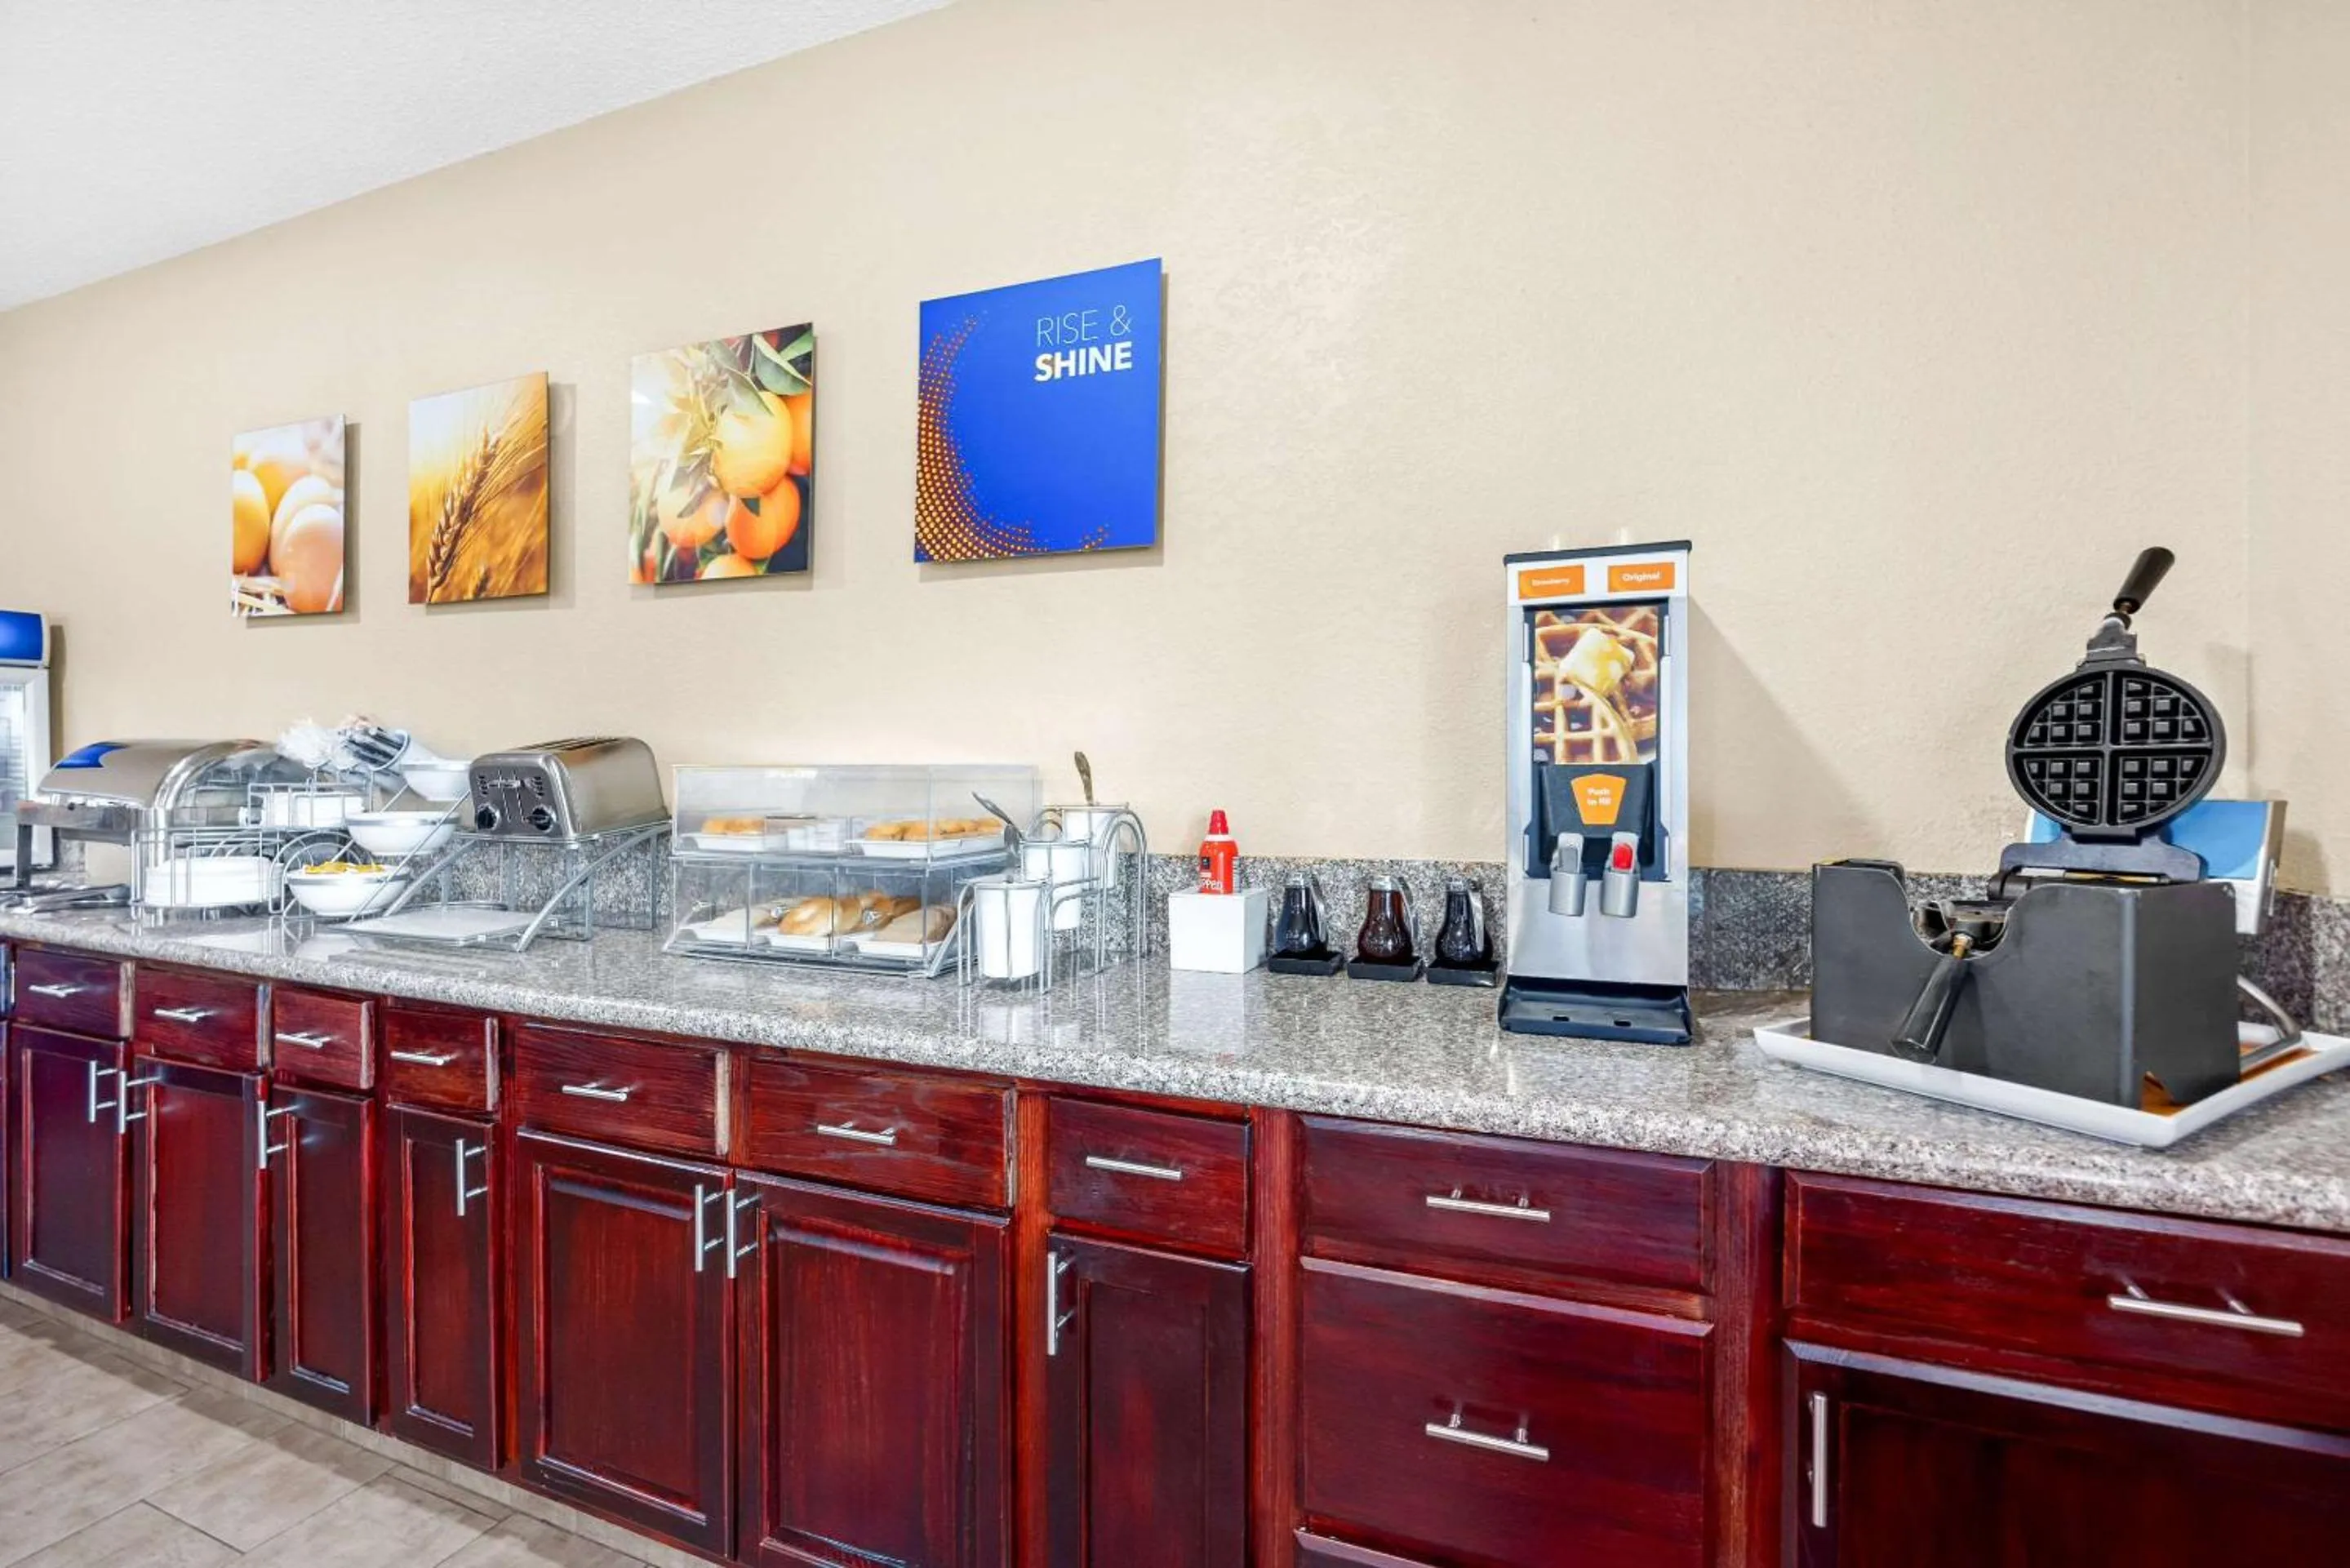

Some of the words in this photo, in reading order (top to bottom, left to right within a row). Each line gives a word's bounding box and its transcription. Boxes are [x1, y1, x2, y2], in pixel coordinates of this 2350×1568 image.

[1037, 309, 1099, 348] RISE
[1109, 304, 1132, 336] &
[1034, 341, 1133, 382] SHINE
[1621, 571, 1660, 582] Original
